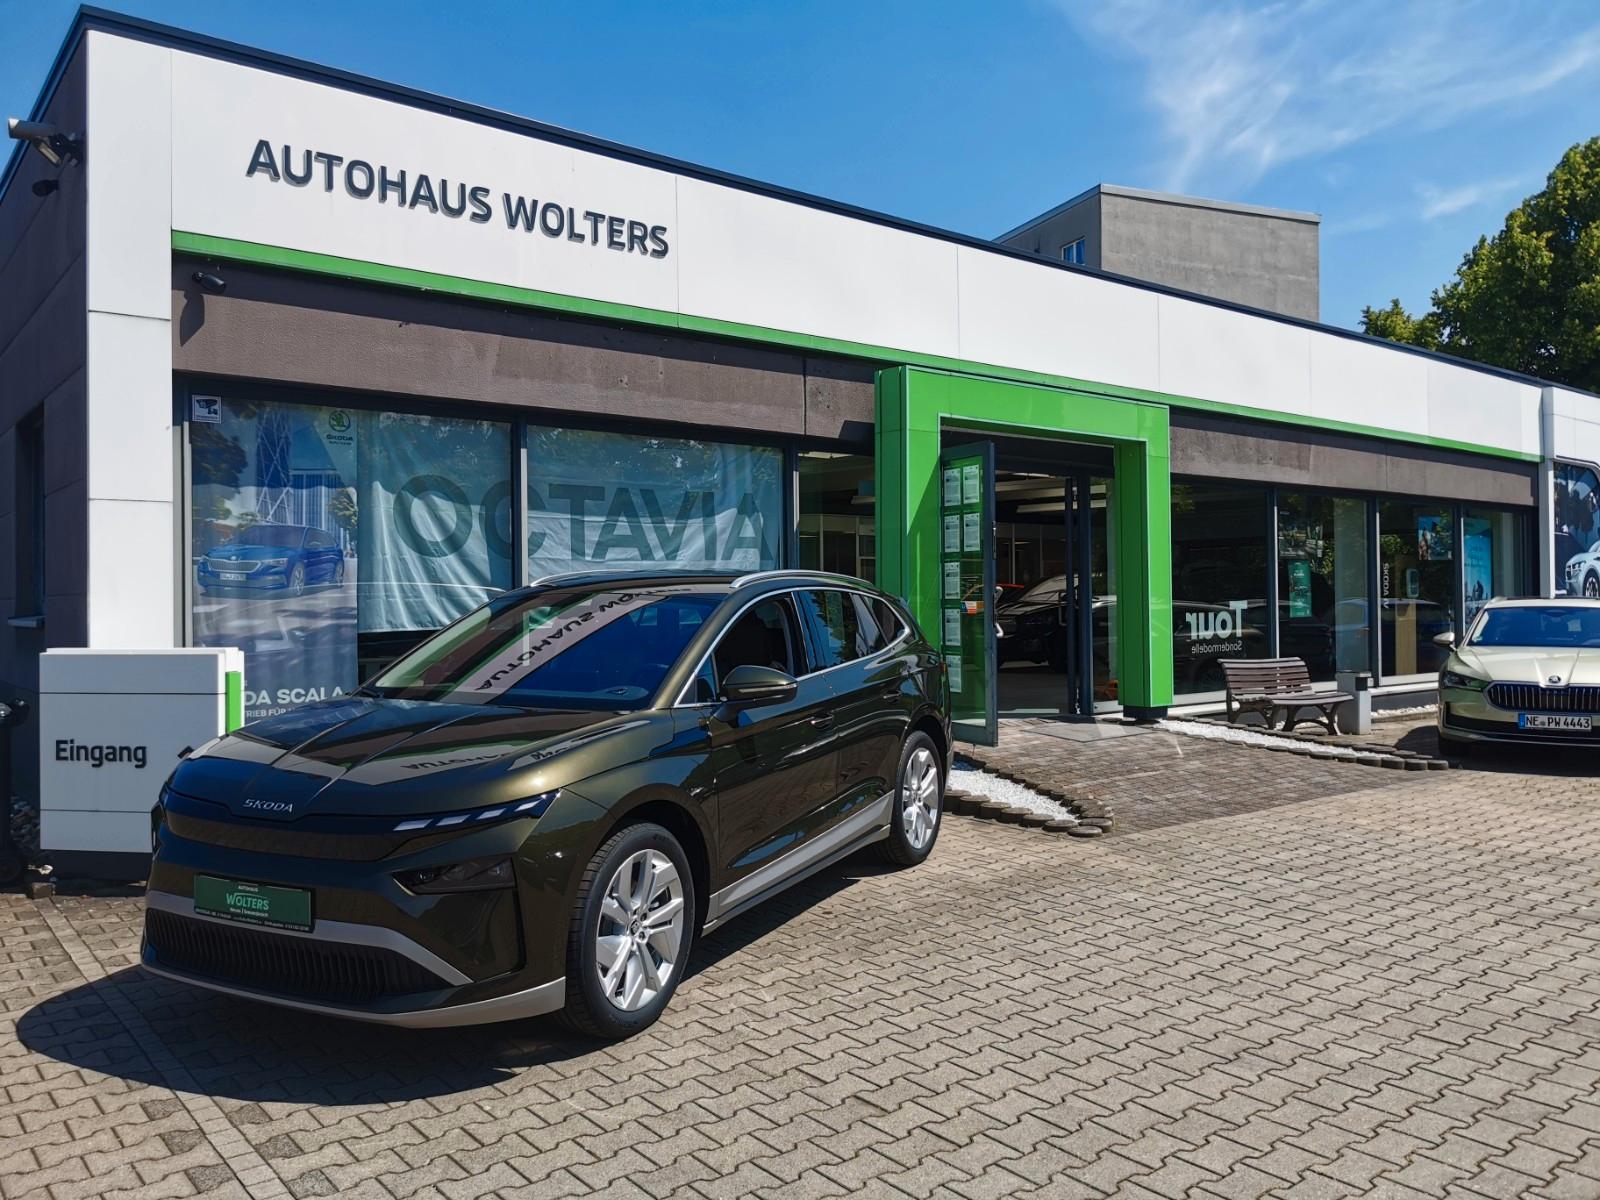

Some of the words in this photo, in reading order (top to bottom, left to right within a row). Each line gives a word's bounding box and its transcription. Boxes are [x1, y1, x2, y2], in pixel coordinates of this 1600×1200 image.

[246, 139, 493, 222] AUTOHAUS
[503, 193, 669, 258] WOLTERS
[393, 474, 774, 561] OCTAVIA
[277, 686, 343, 704] SCALA
[1526, 716, 1538, 726] NE
[1563, 717, 1590, 728] 4443
[55, 739, 147, 768] Eingang
[226, 892, 269, 910] WOLTERS
